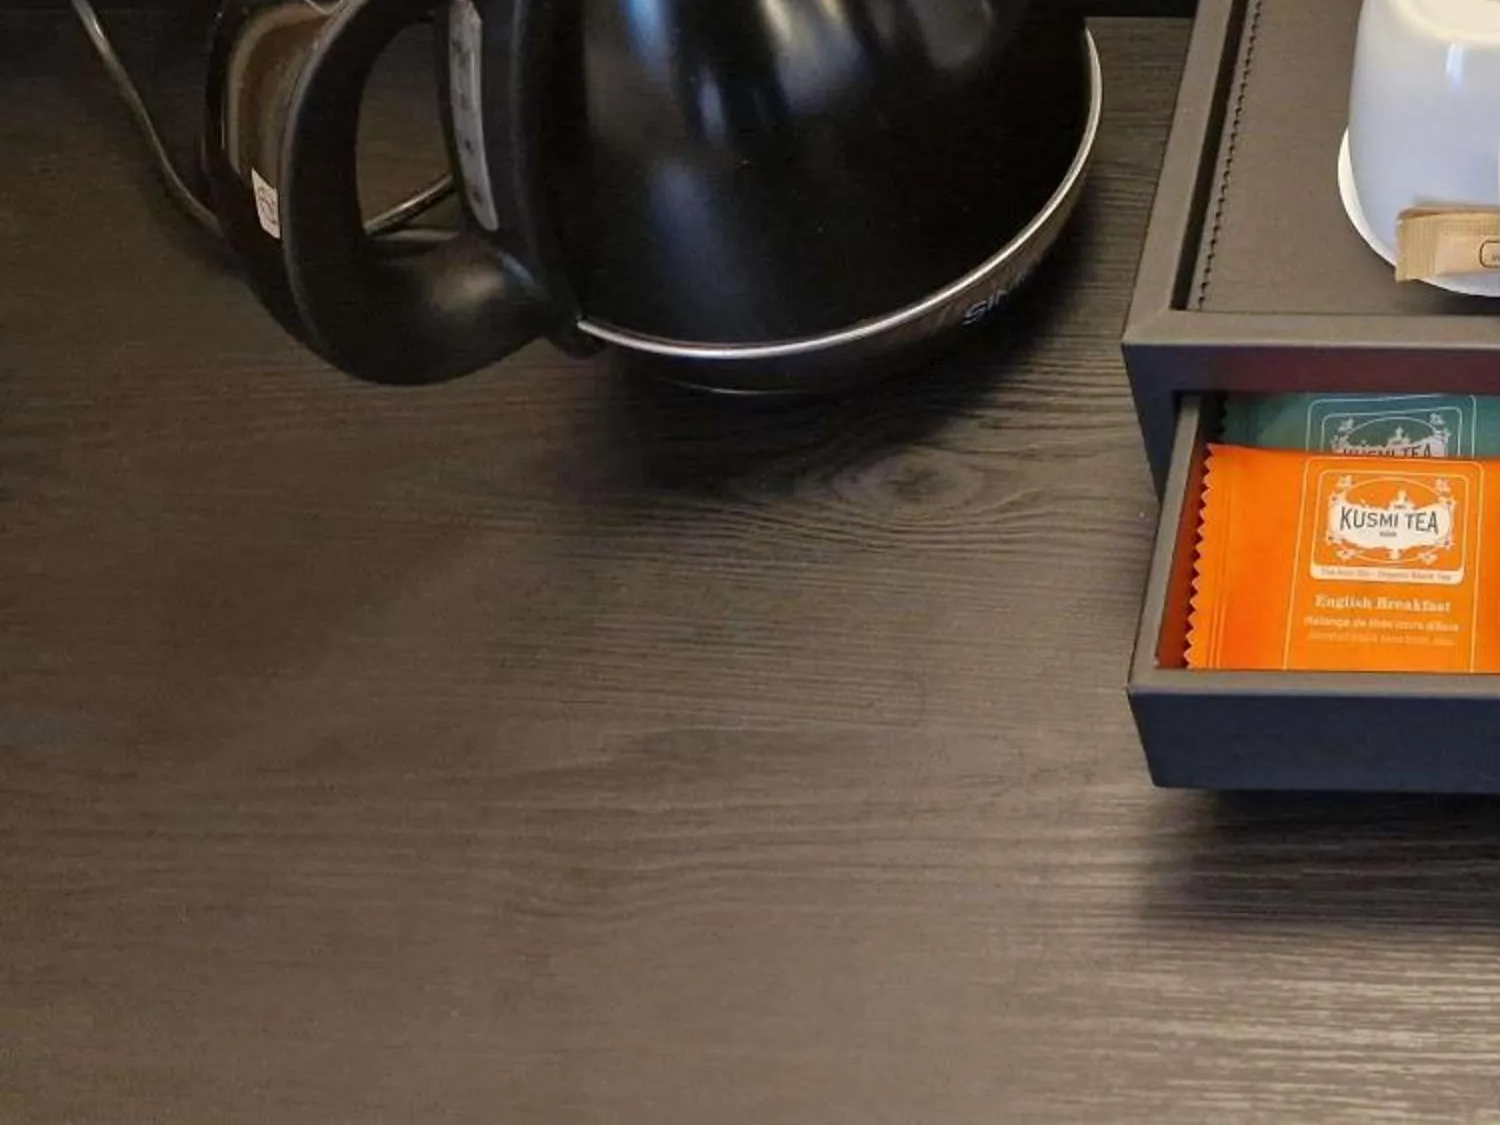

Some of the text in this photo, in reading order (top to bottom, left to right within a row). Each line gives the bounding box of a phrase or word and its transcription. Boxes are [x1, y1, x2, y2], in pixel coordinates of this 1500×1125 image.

[1339, 506, 1439, 535] KUSMI TEA
[1314, 594, 1451, 613] English Breakfast
